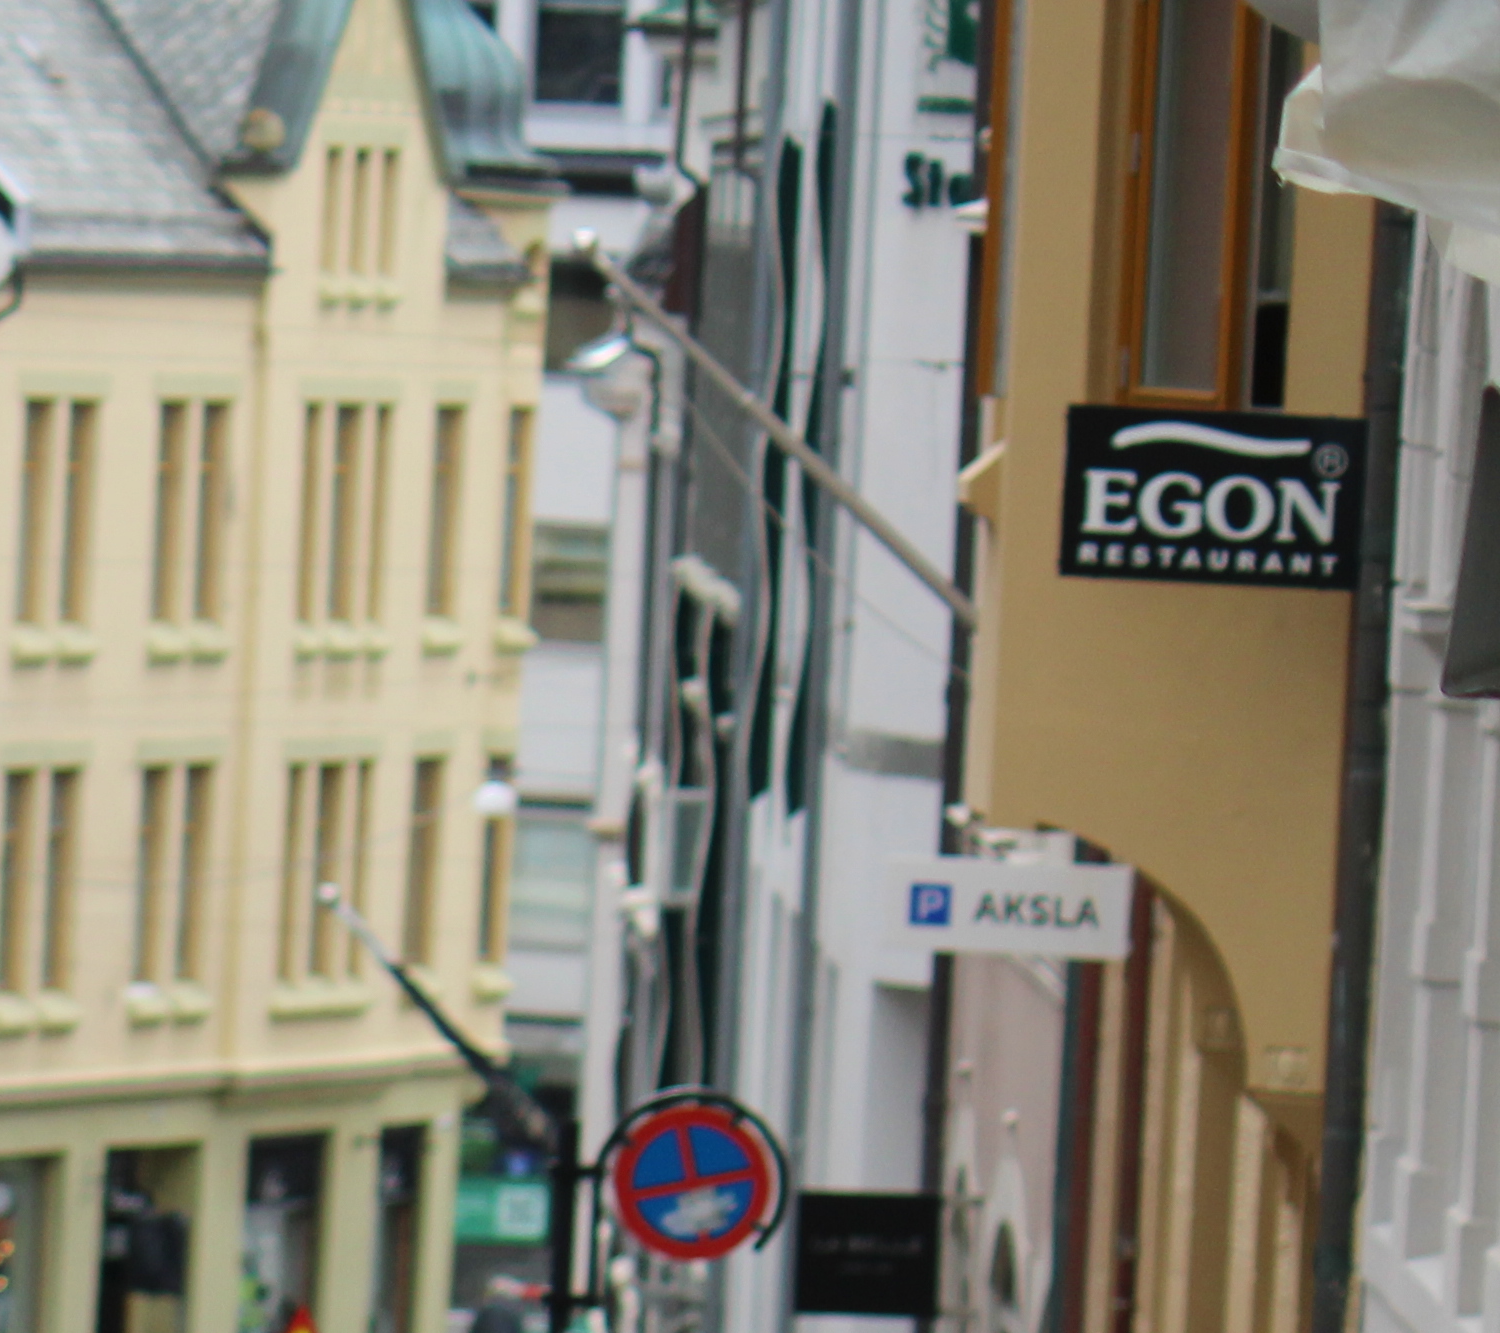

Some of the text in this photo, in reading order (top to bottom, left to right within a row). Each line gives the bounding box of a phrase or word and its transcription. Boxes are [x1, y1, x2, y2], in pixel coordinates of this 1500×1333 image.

[1082, 467, 1341, 545] EGON
[1075, 542, 1340, 576] RESTAURANT
[917, 889, 1100, 929] P AKSLA
